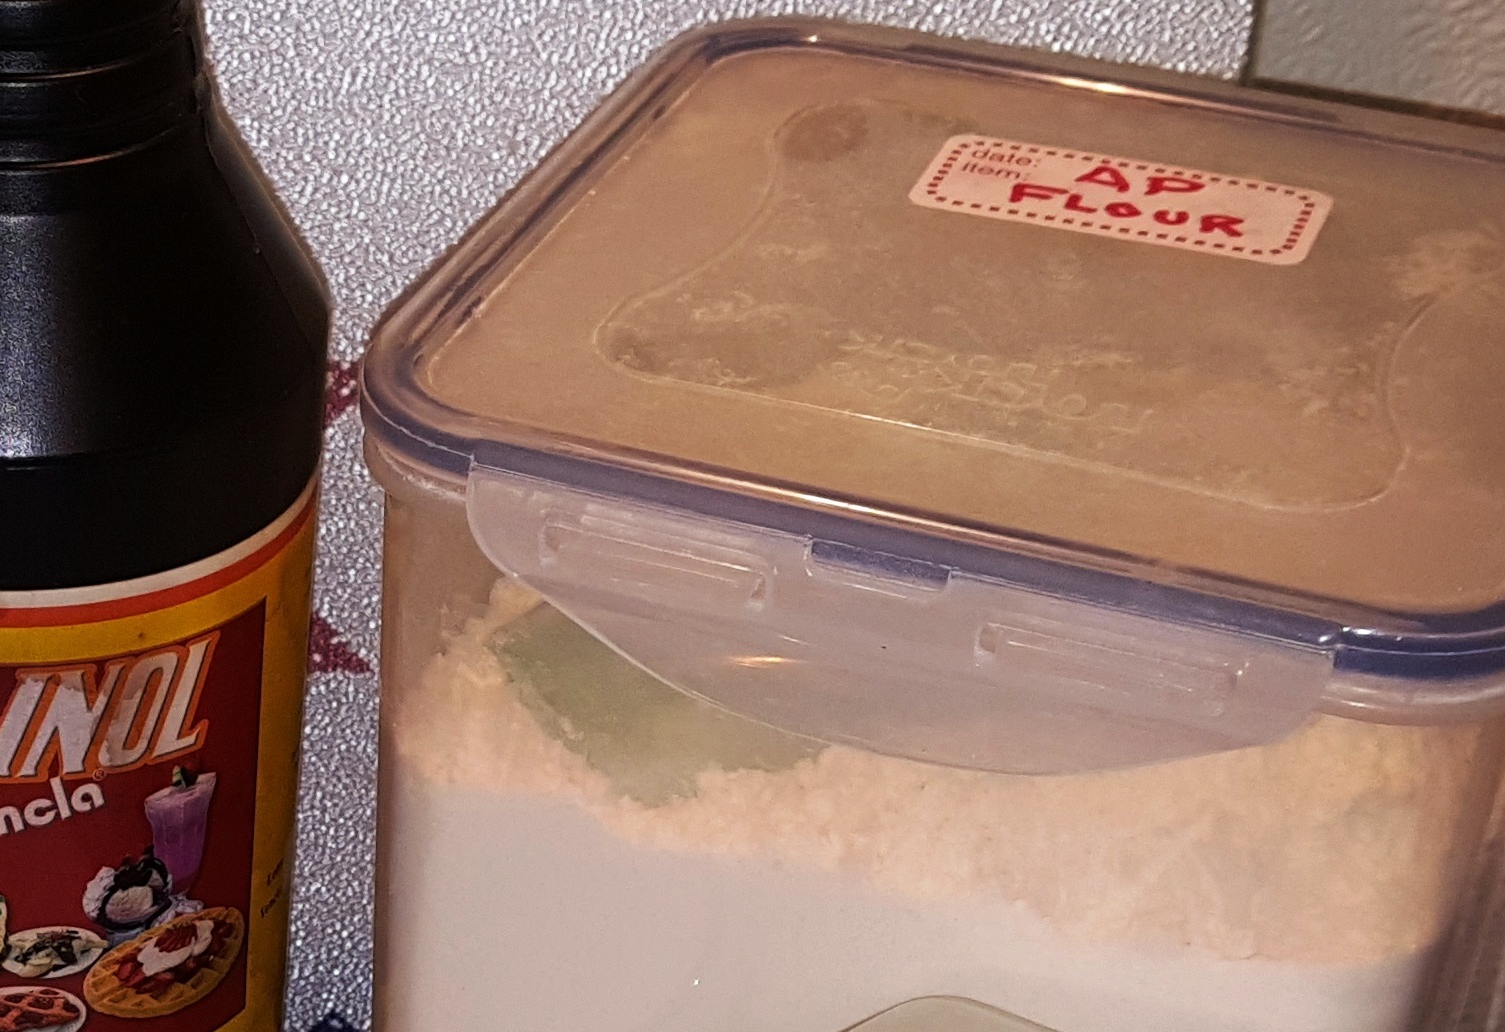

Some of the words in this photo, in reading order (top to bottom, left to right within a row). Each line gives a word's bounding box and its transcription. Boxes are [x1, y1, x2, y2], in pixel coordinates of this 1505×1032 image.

[971, 148, 1039, 169] date:
[959, 162, 1031, 182] item:
[1008, 183, 1246, 238] FLOUR
